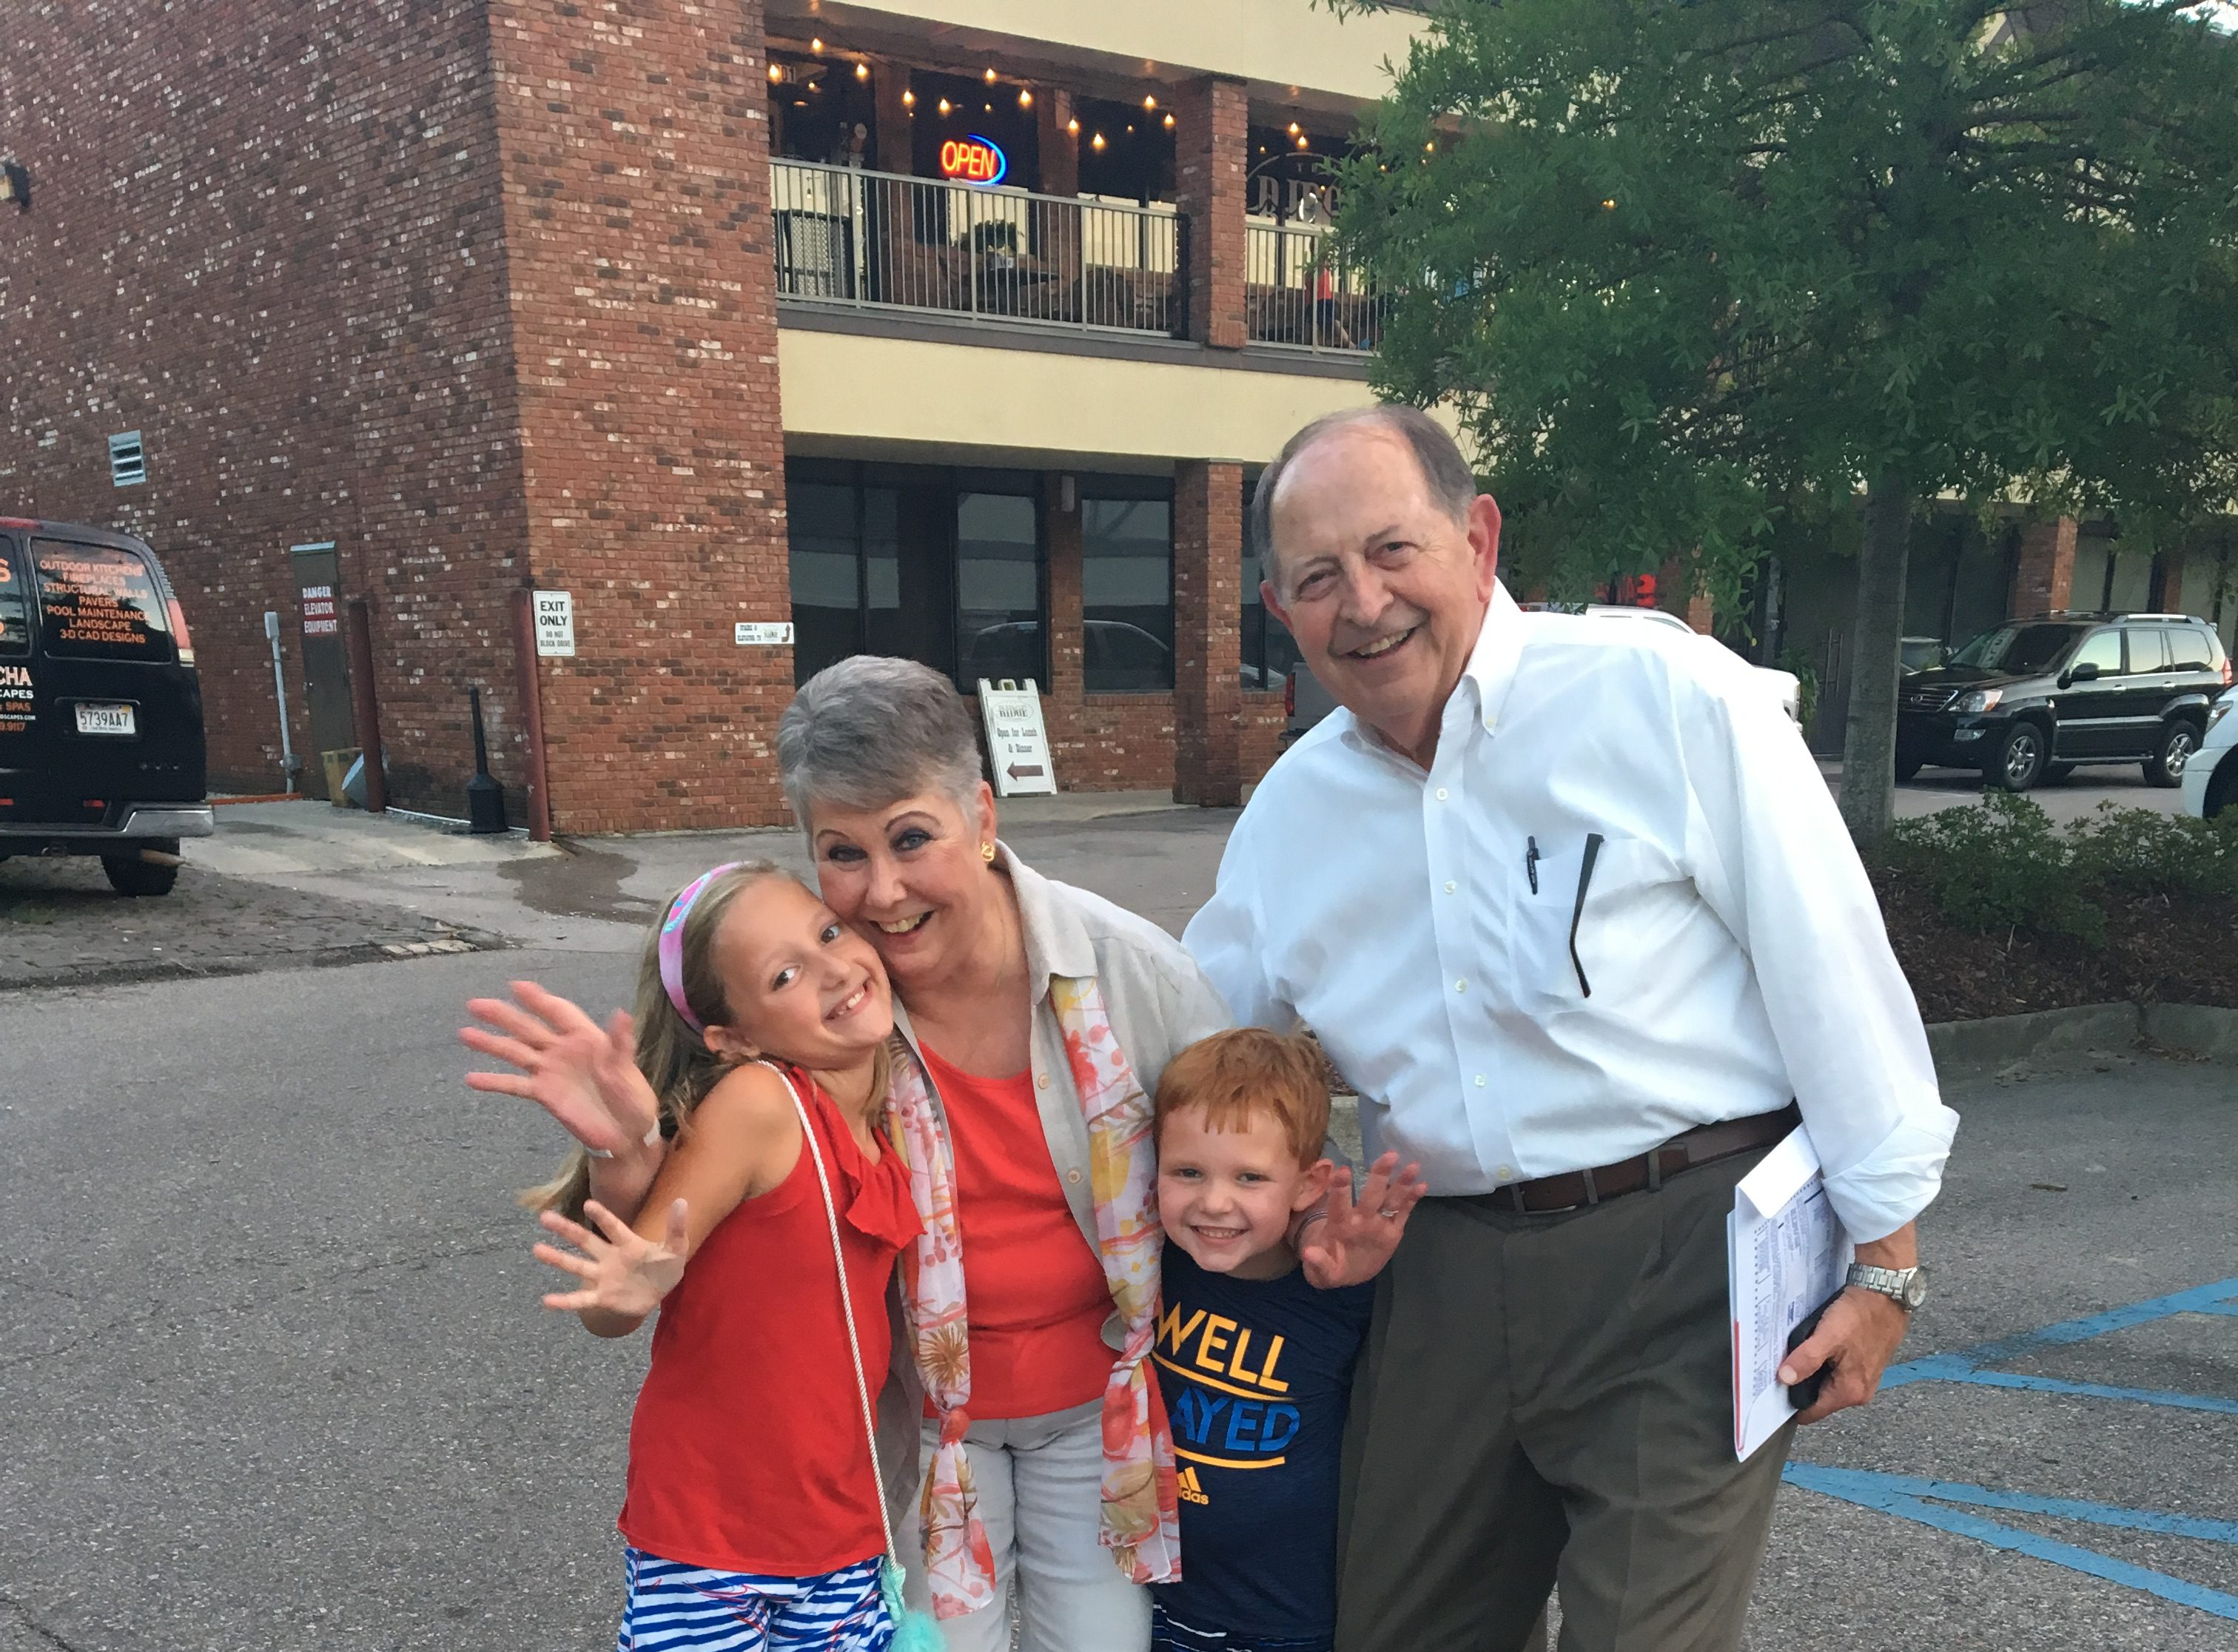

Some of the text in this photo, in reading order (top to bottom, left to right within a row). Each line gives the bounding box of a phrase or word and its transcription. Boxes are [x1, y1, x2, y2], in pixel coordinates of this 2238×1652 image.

[941, 141, 995, 178] OPEN
[39, 560, 144, 577] OUTDOOR KITCHENS
[62, 572, 126, 586] FIREPLACES
[43, 582, 147, 599] STRUCTURAL WALLS
[303, 586, 331, 598] DANGER
[78, 596, 118, 607] PAVERS
[540, 600, 565, 611] EXIT
[47, 605, 150, 621] POOL MAINTENANCE
[304, 602, 334, 615] ELEVATOR
[69, 619, 131, 631] LANDSCAPE
[304, 620, 337, 633] EQUIPMENT
[540, 615, 568, 625] ONLY
[60, 629, 146, 643] 3-D CAD DESIGNS
[6, 702, 31, 712] SPAS
[79, 711, 128, 727] 5739AA7
[997, 728, 1010, 739] Open
[1021, 728, 1038, 737] Lunch
[1155, 1301, 1289, 1392] WELL
